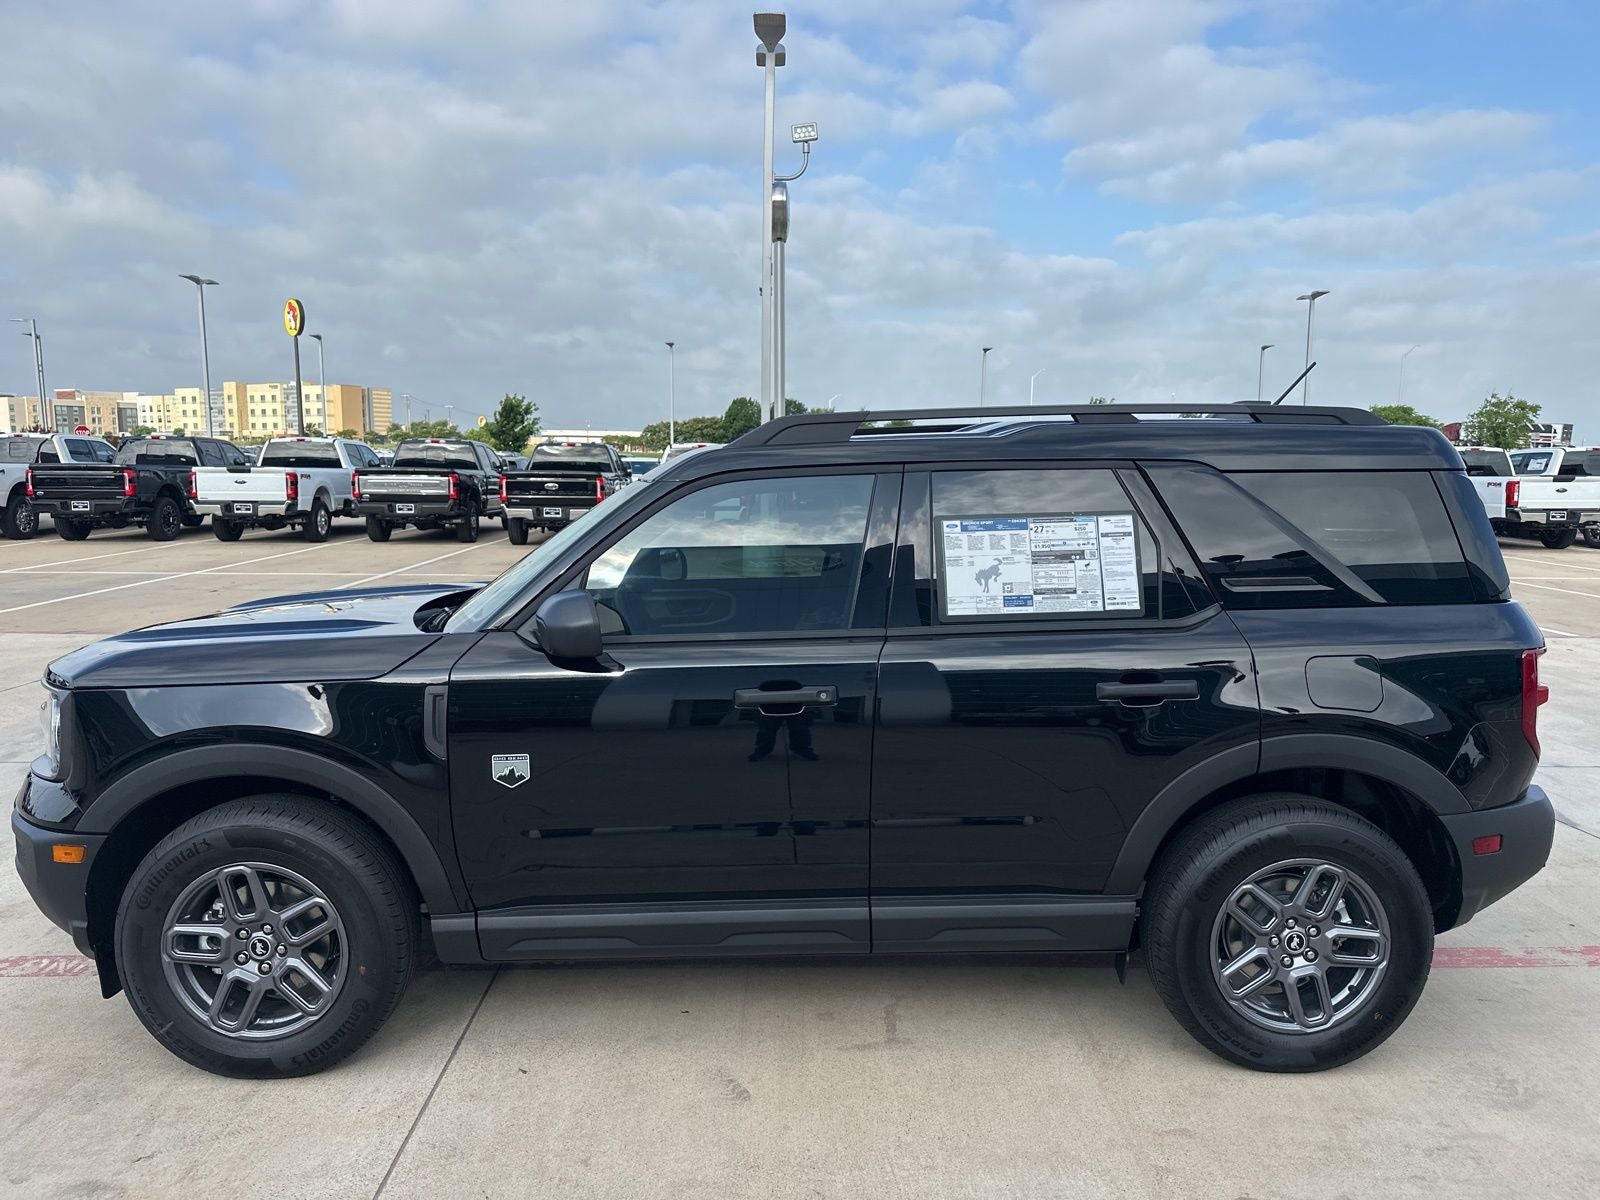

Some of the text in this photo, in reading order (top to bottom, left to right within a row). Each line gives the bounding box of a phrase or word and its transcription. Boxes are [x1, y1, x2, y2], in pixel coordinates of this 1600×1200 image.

[137, 841, 200, 910] Continental
[1196, 841, 1265, 903] Continental
[303, 998, 370, 1063] Continental
